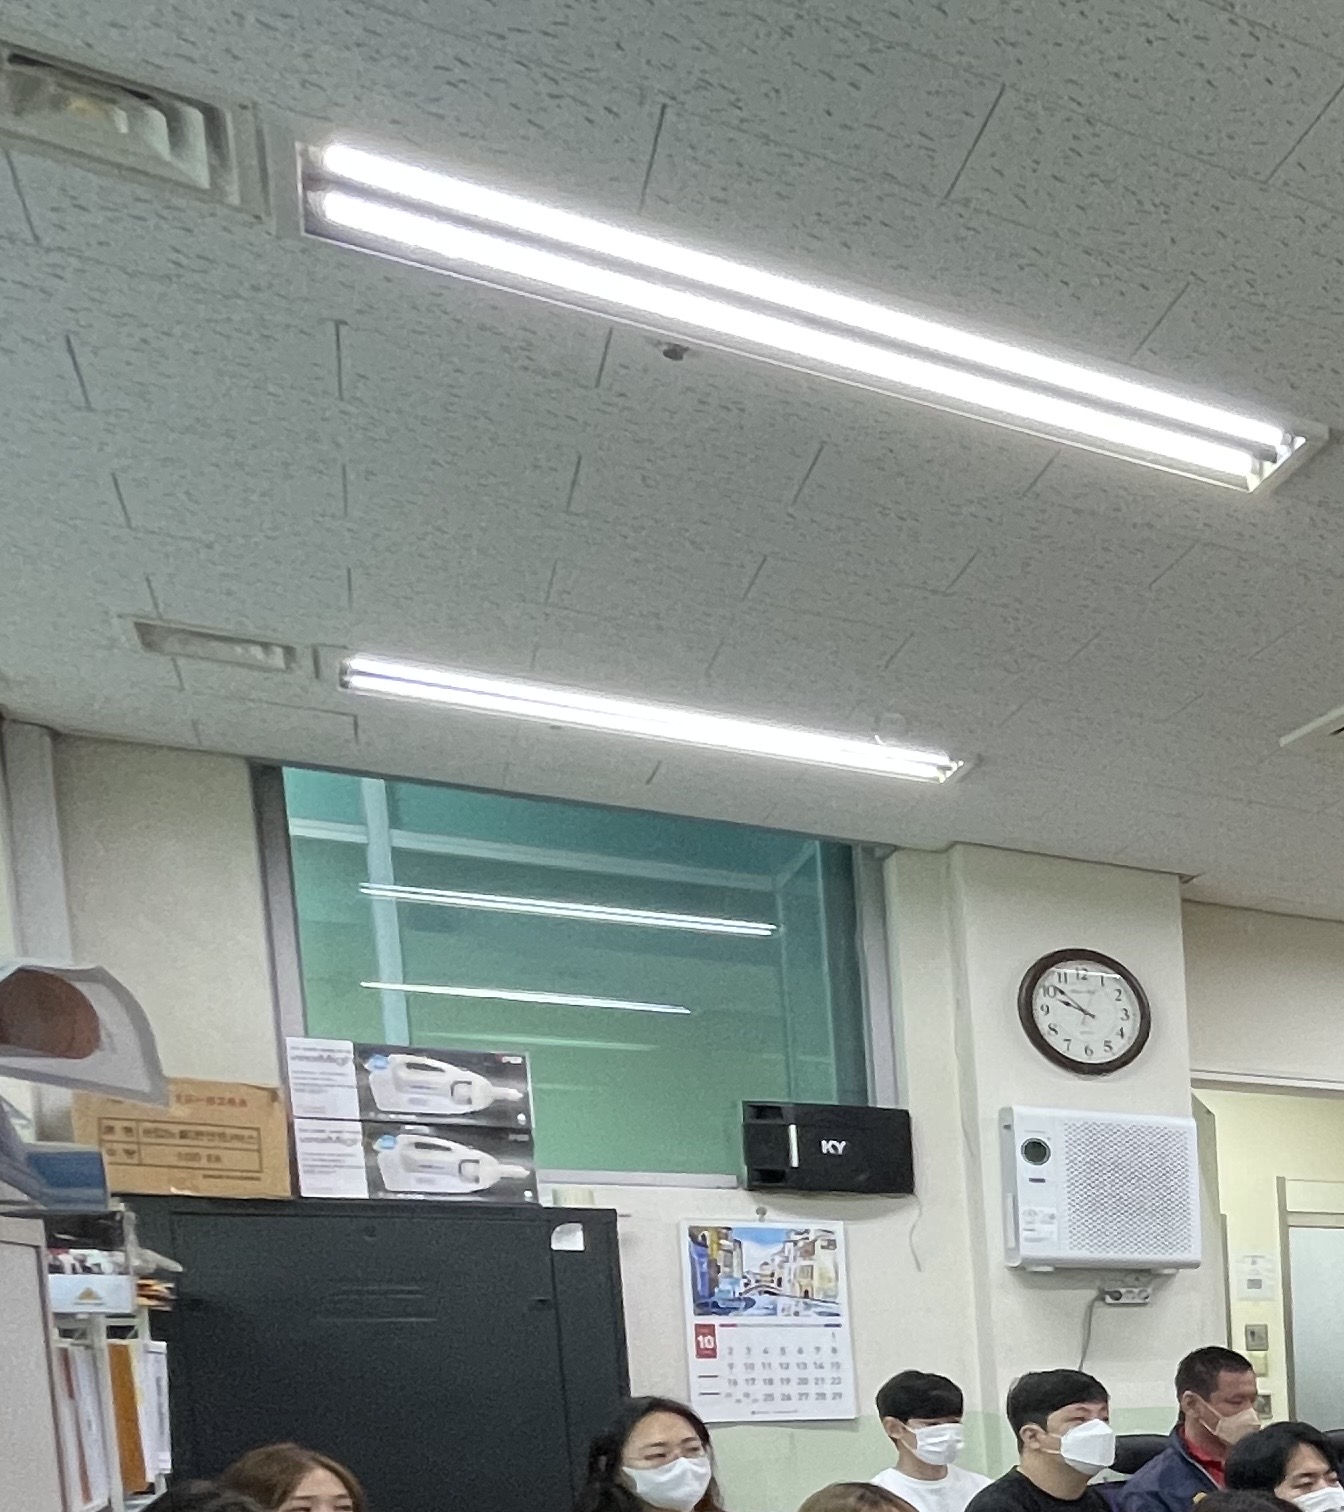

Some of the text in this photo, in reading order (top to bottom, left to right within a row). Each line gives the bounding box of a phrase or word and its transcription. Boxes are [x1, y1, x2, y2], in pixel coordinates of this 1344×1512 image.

[1057, 971, 1068, 984] 11
[1100, 975, 1105, 987] 1
[1040, 984, 1057, 998] 10
[1114, 988, 1122, 1002] 2
[1040, 1004, 1050, 1016] 9
[1120, 1008, 1130, 1021] 3
[1047, 1023, 1059, 1037] 8
[1115, 1027, 1124, 1039] 4
[1063, 1038, 1072, 1051] 7
[1084, 1045, 1094, 1057] 6
[1103, 1040, 1113, 1053] 5
[821, 1139, 847, 1155] KY
[697, 1334, 714, 1349] 10
